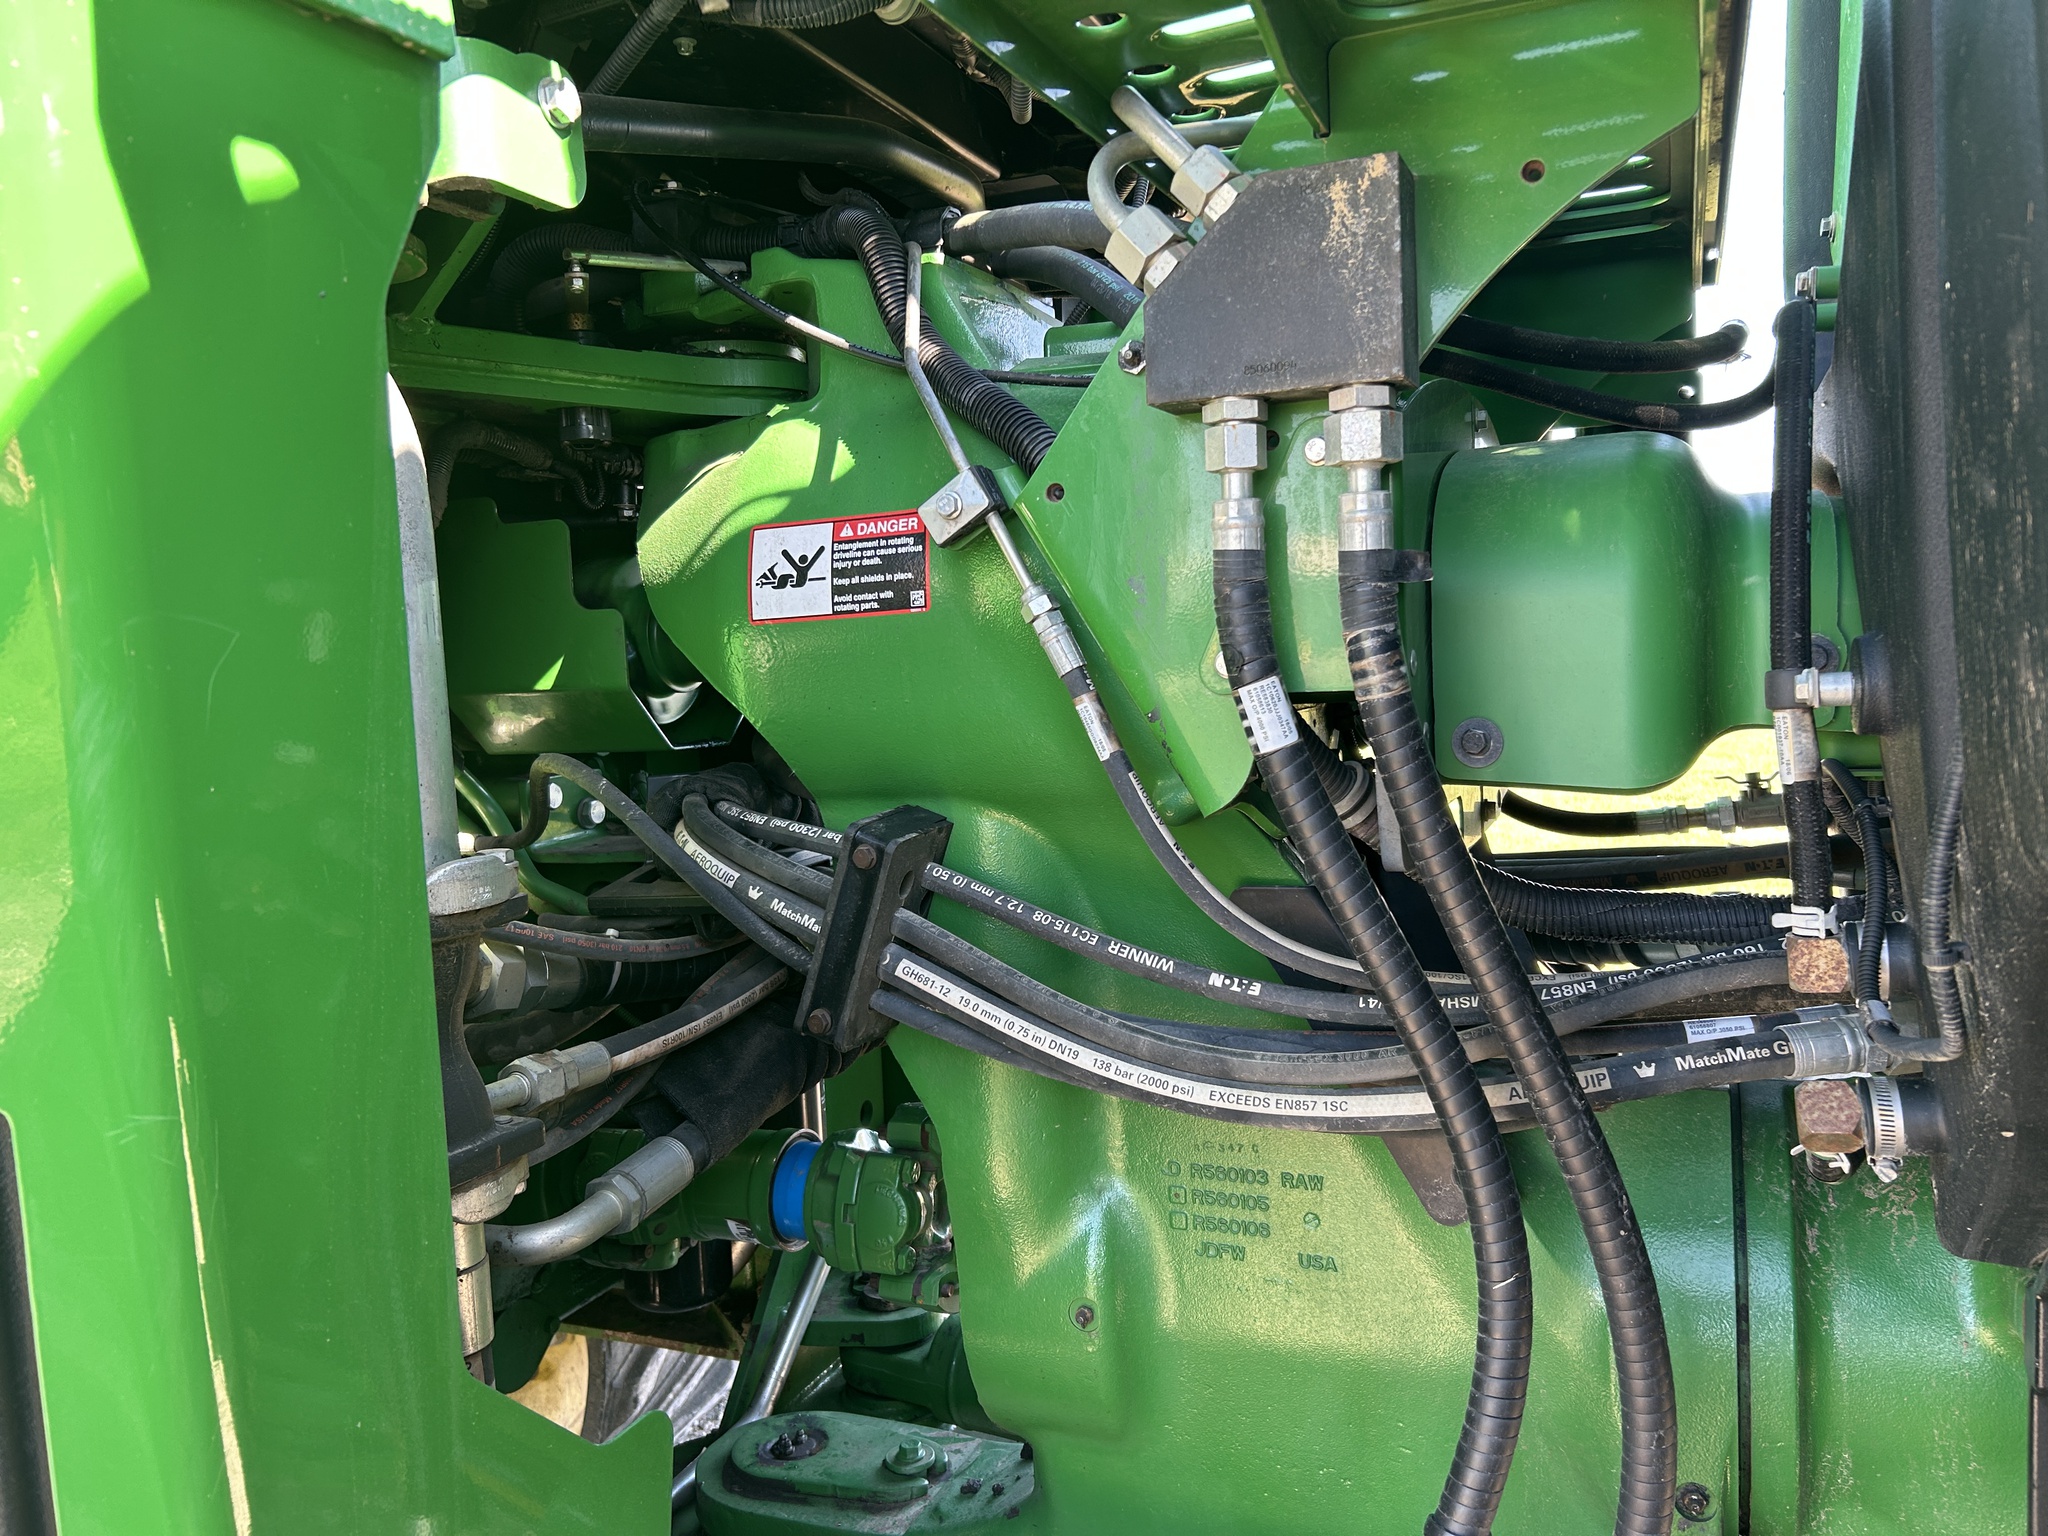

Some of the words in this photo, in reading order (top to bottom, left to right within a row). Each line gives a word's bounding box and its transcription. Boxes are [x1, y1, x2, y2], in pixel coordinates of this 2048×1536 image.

[857, 517, 918, 536] DANGER
[833, 540, 879, 550] Entanglement
[887, 537, 914, 548] rotating
[833, 550, 862, 559] driveline
[897, 545, 922, 553] serious
[833, 560, 852, 569] injury
[862, 557, 882, 566] death.
[833, 578, 850, 586] Keep
[851, 576, 859, 584] all
[860, 574, 884, 583] shields
[894, 572, 914, 582] place.
[834, 594, 852, 603] Avoid
[853, 592, 878, 601] contact
[879, 591, 893, 599] with
[834, 603, 860, 612] rotating
[861, 601, 879, 611] parts.
[1271, 681, 1282, 702] EATON
[1083, 705, 1095, 725] EATON
[1252, 705, 1260, 715] O/P
[1257, 717, 1265, 731] 4000
[1262, 731, 1270, 742] PSI
[1781, 715, 1789, 740] EATON
[769, 819, 790, 828] psi)
[789, 822, 821, 838] (2300
[822, 830, 843, 843] bar
[690, 849, 736, 884] AEROQUIP
[1657, 864, 1728, 883] AEROQUIP
[931, 867, 968, 888] (0.50
[970, 880, 995, 898] mm
[994, 894, 1024, 914] 12.7
[537, 931, 555, 941] SAE
[1032, 909, 1100, 946] EC115-08
[575, 938, 598, 949] (3050
[611, 943, 623, 951] 210
[1107, 940, 1175, 974] WINNER
[758, 983, 770, 994] bar
[1540, 980, 1597, 1001] EN857
[703, 1011, 723, 1028] EN853
[899, 962, 952, 1000] GH681-12
[956, 992, 982, 1017] 19.0
[980, 1005, 1003, 1028] mm
[1002, 1017, 1032, 1042] (0.75
[1029, 1028, 1048, 1048] in)
[1047, 1038, 1081, 1063] DN19
[1090, 1055, 1113, 1074] 138
[1113, 1065, 1136, 1083] bar
[1135, 1071, 1170, 1094] (2000
[1170, 1080, 1196, 1099] psi)
[1207, 1089, 1273, 1112] EXCEEDS
[1274, 1097, 1319, 1114] EN857
[1321, 1098, 1350, 1114] 1SC
[1674, 1045, 1771, 1072] MatchMate
[1690, 1028, 1705, 1036] MAX
[595, 1096, 613, 1110] Made
[568, 1113, 589, 1128] USA
[1190, 1162, 1270, 1186] R560103
[1280, 1172, 1325, 1192] RAW
[1191, 1188, 1271, 1212] R560105
[1192, 1215, 1271, 1238] R560106
[1194, 1242, 1246, 1262] JDFW
[1297, 1252, 1338, 1273] USA
